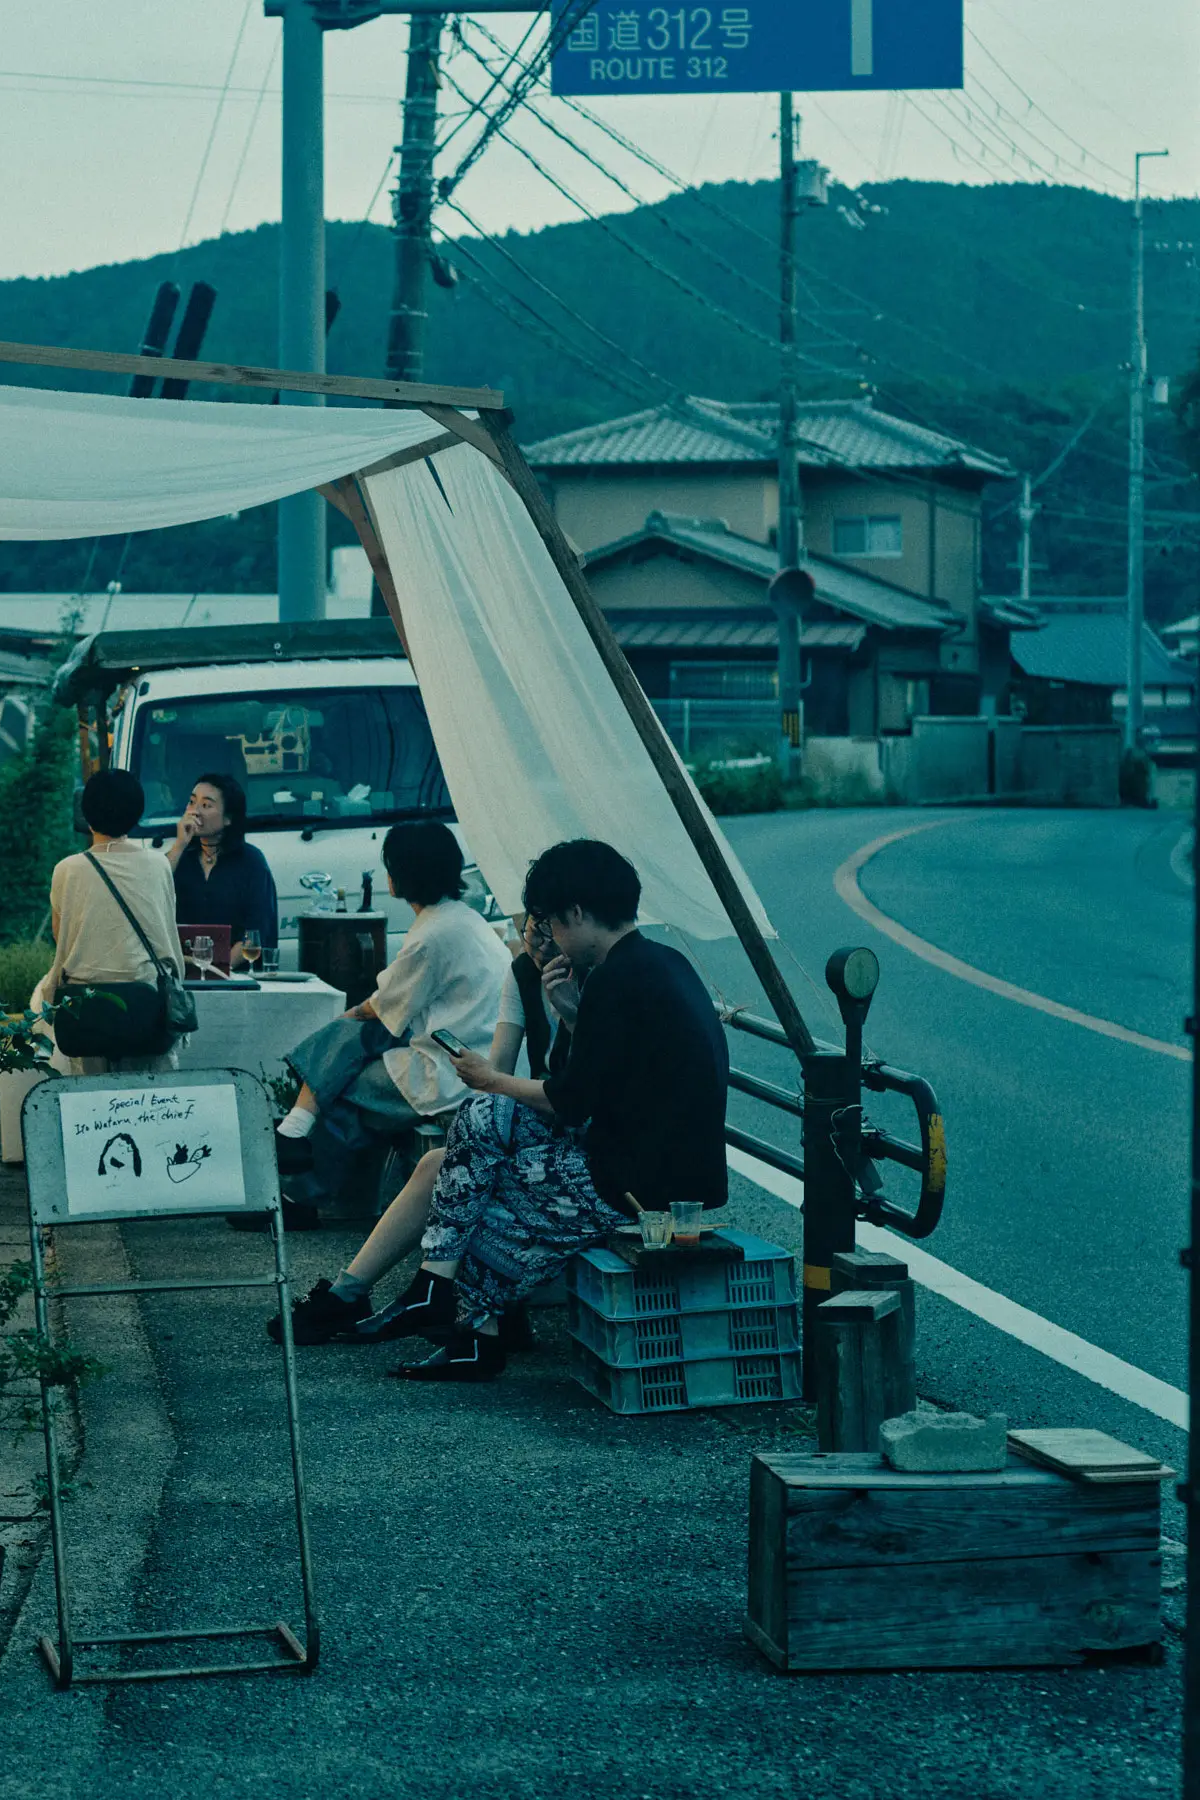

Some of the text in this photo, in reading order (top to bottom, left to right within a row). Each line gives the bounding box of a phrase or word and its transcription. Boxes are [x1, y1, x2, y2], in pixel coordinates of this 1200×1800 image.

[567, 8, 753, 52] 国道312号
[590, 56, 729, 80] ROUTE 312
[109, 1093, 180, 1113] Special Event
[138, 1111, 156, 1123] the
[160, 1103, 195, 1120] chief
